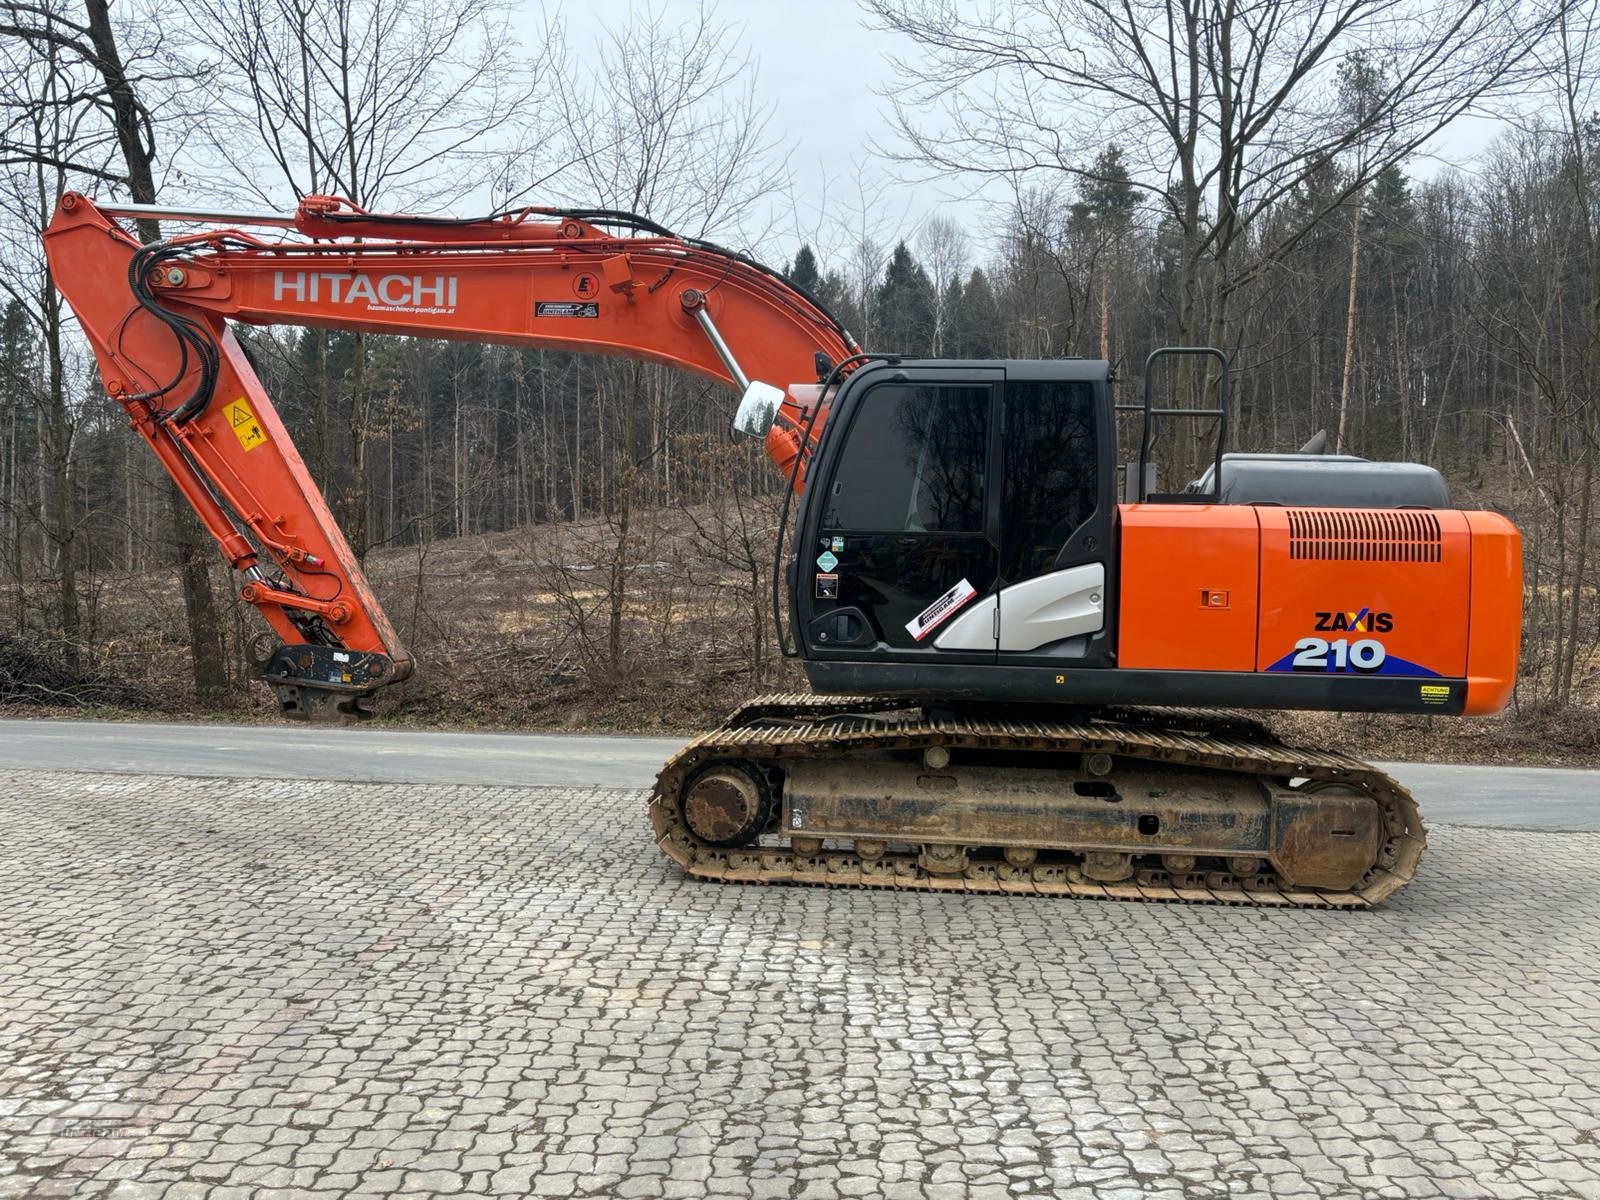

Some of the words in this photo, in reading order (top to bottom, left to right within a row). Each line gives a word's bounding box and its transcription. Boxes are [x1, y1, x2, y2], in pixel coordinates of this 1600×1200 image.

[273, 271, 458, 307] HITACHI
[1314, 607, 1394, 633] ZAXIS
[1292, 637, 1386, 672] 210
